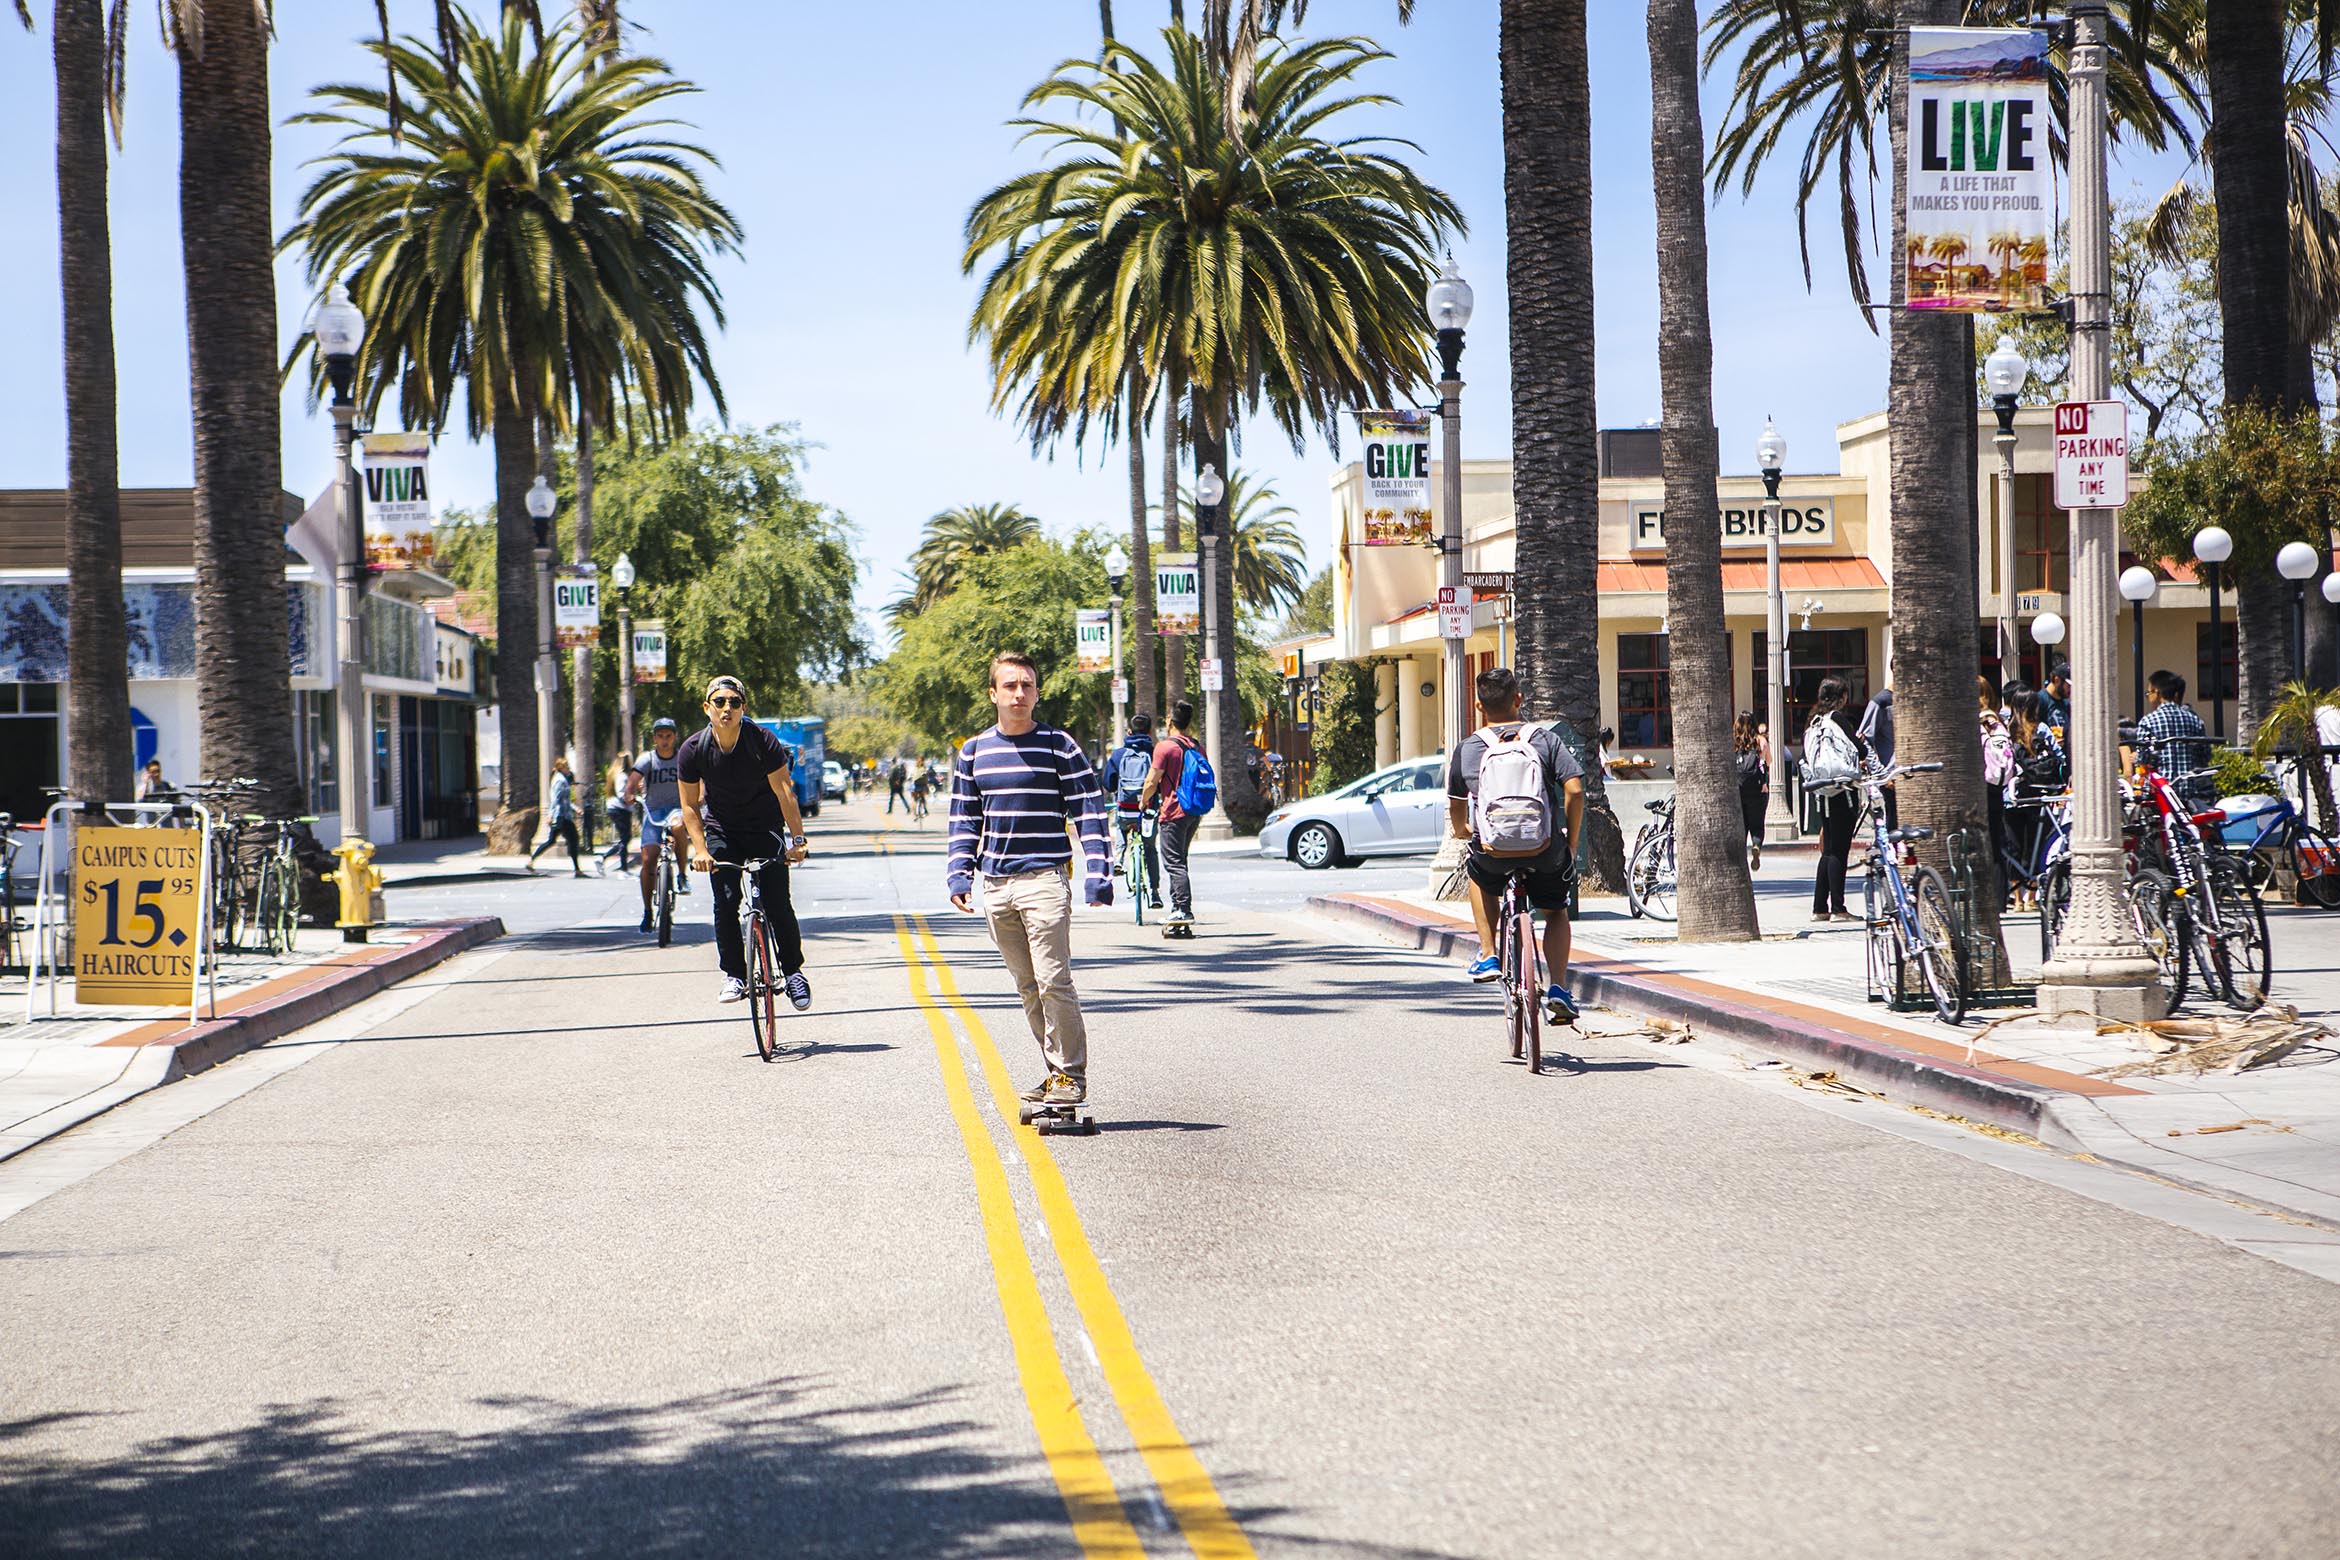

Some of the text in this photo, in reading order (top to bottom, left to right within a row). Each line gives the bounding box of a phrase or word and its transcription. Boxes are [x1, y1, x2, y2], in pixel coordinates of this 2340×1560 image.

[1921, 98, 2034, 171] LIVE
[1940, 177, 2016, 191] A LIFE THAT
[1912, 196, 2043, 211] MAKES YOU PROUD.
[2060, 407, 2085, 431] NO
[2059, 438, 2124, 458] PARKING
[1366, 443, 1429, 479] GIVE
[2079, 462, 2104, 476] ANY
[365, 466, 428, 502] VIVA
[1404, 480, 1424, 488] YOUR
[2078, 480, 2105, 495] TIME
[1158, 574, 1196, 594] VIVA
[1463, 575, 1503, 587] EMBARCADERO
[557, 585, 596, 607] GIVE
[1441, 590, 1453, 602] NO
[1441, 605, 1469, 615] PARKING
[1081, 626, 1105, 641] LIVE
[635, 636, 662, 652] VIVA
[82, 845, 195, 868] CAMPUS CUTS
[82, 954, 191, 976] HAIRCUTS
